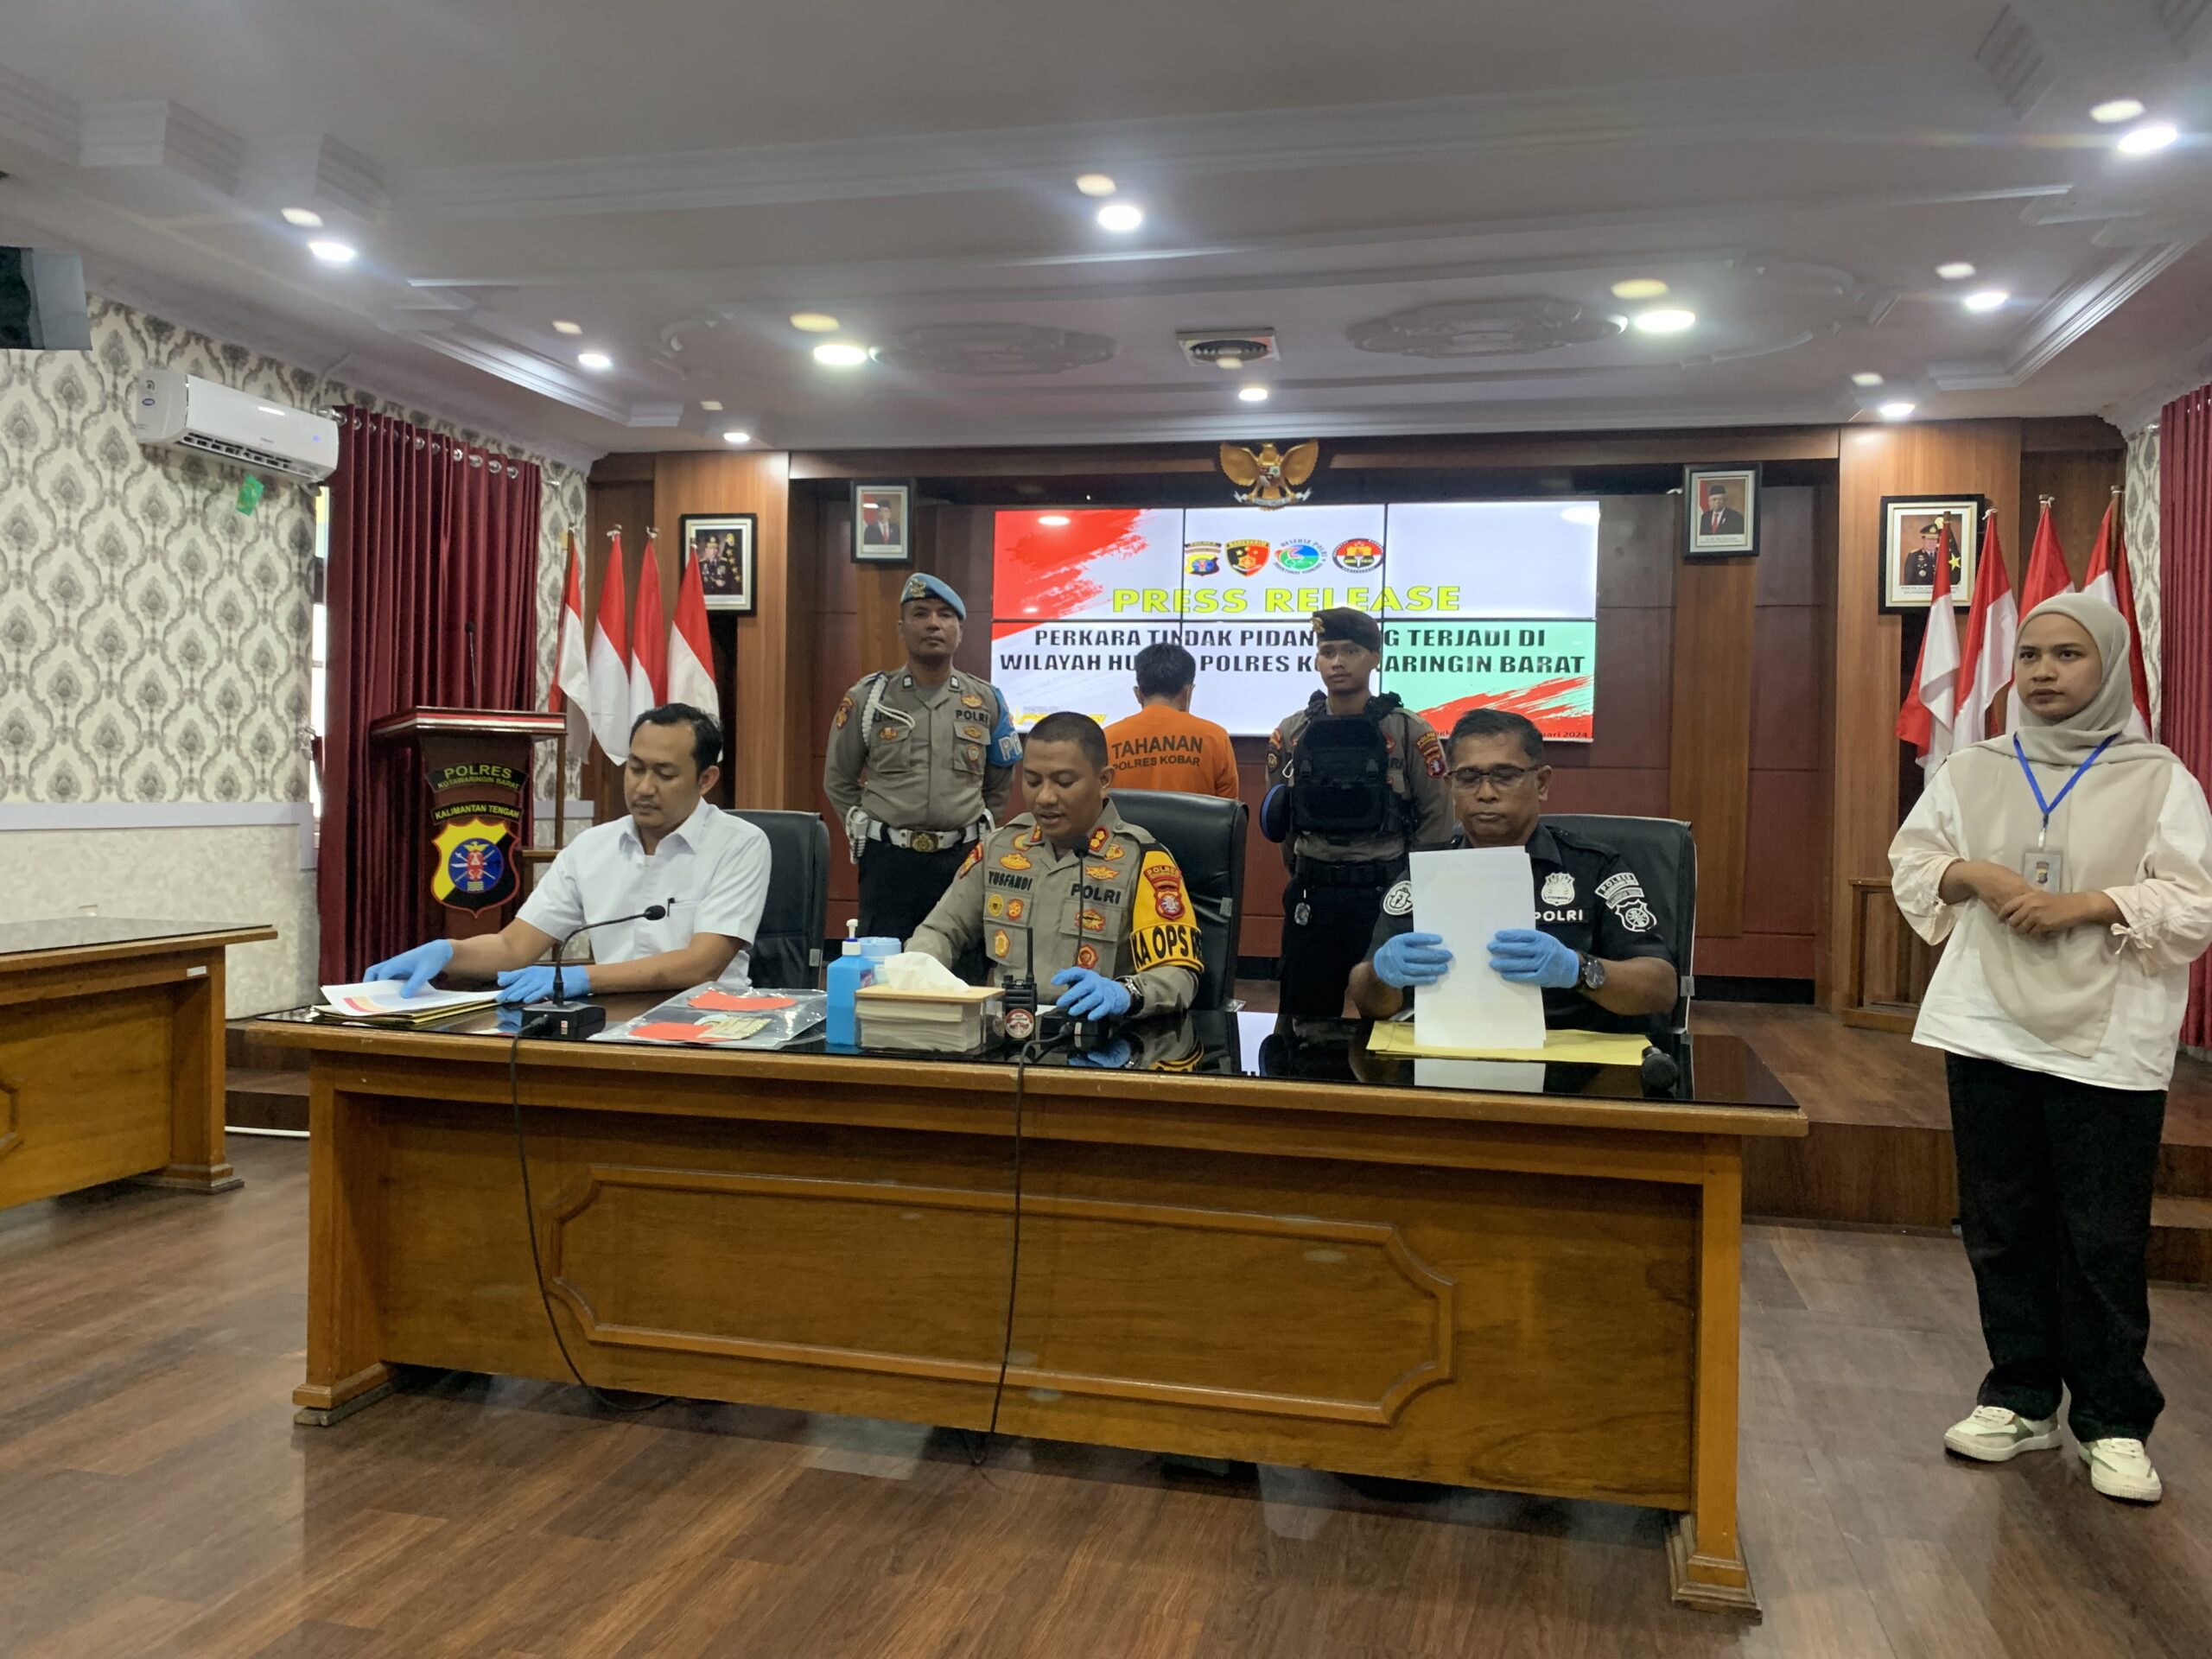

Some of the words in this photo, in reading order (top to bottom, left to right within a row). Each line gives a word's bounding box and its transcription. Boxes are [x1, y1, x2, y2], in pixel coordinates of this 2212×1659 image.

[1112, 588, 1248, 613] PRESS
[1265, 586, 1460, 613] RELEASE
[1035, 630, 1141, 645] PERKARA
[1147, 630, 1231, 646] TINDAK
[1240, 630, 1313, 646] PIDAN
[1408, 629, 1511, 647] TERJADI
[1519, 629, 1544, 647] DI
[1000, 654, 1101, 671] WILAYAH
[1200, 655, 1289, 671] POLRES
[1499, 655, 1585, 673] BARAT
[956, 709, 989, 724] POLRI
[1111, 734, 1203, 760] TAHANAN
[1113, 757, 1157, 771] POLRES
[1160, 754, 1200, 766] KOBAR
[444, 764, 512, 779] POLRES
[437, 777, 494, 789] KOTAWARINGIN
[496, 779, 520, 789] BARAT
[435, 804, 486, 819] KALIMANTAN
[488, 804, 519, 818] TENGAH
[1071, 882, 1122, 905] POLRI
[1535, 908, 1583, 922] POLRI
[1153, 925, 1189, 959] OPS
